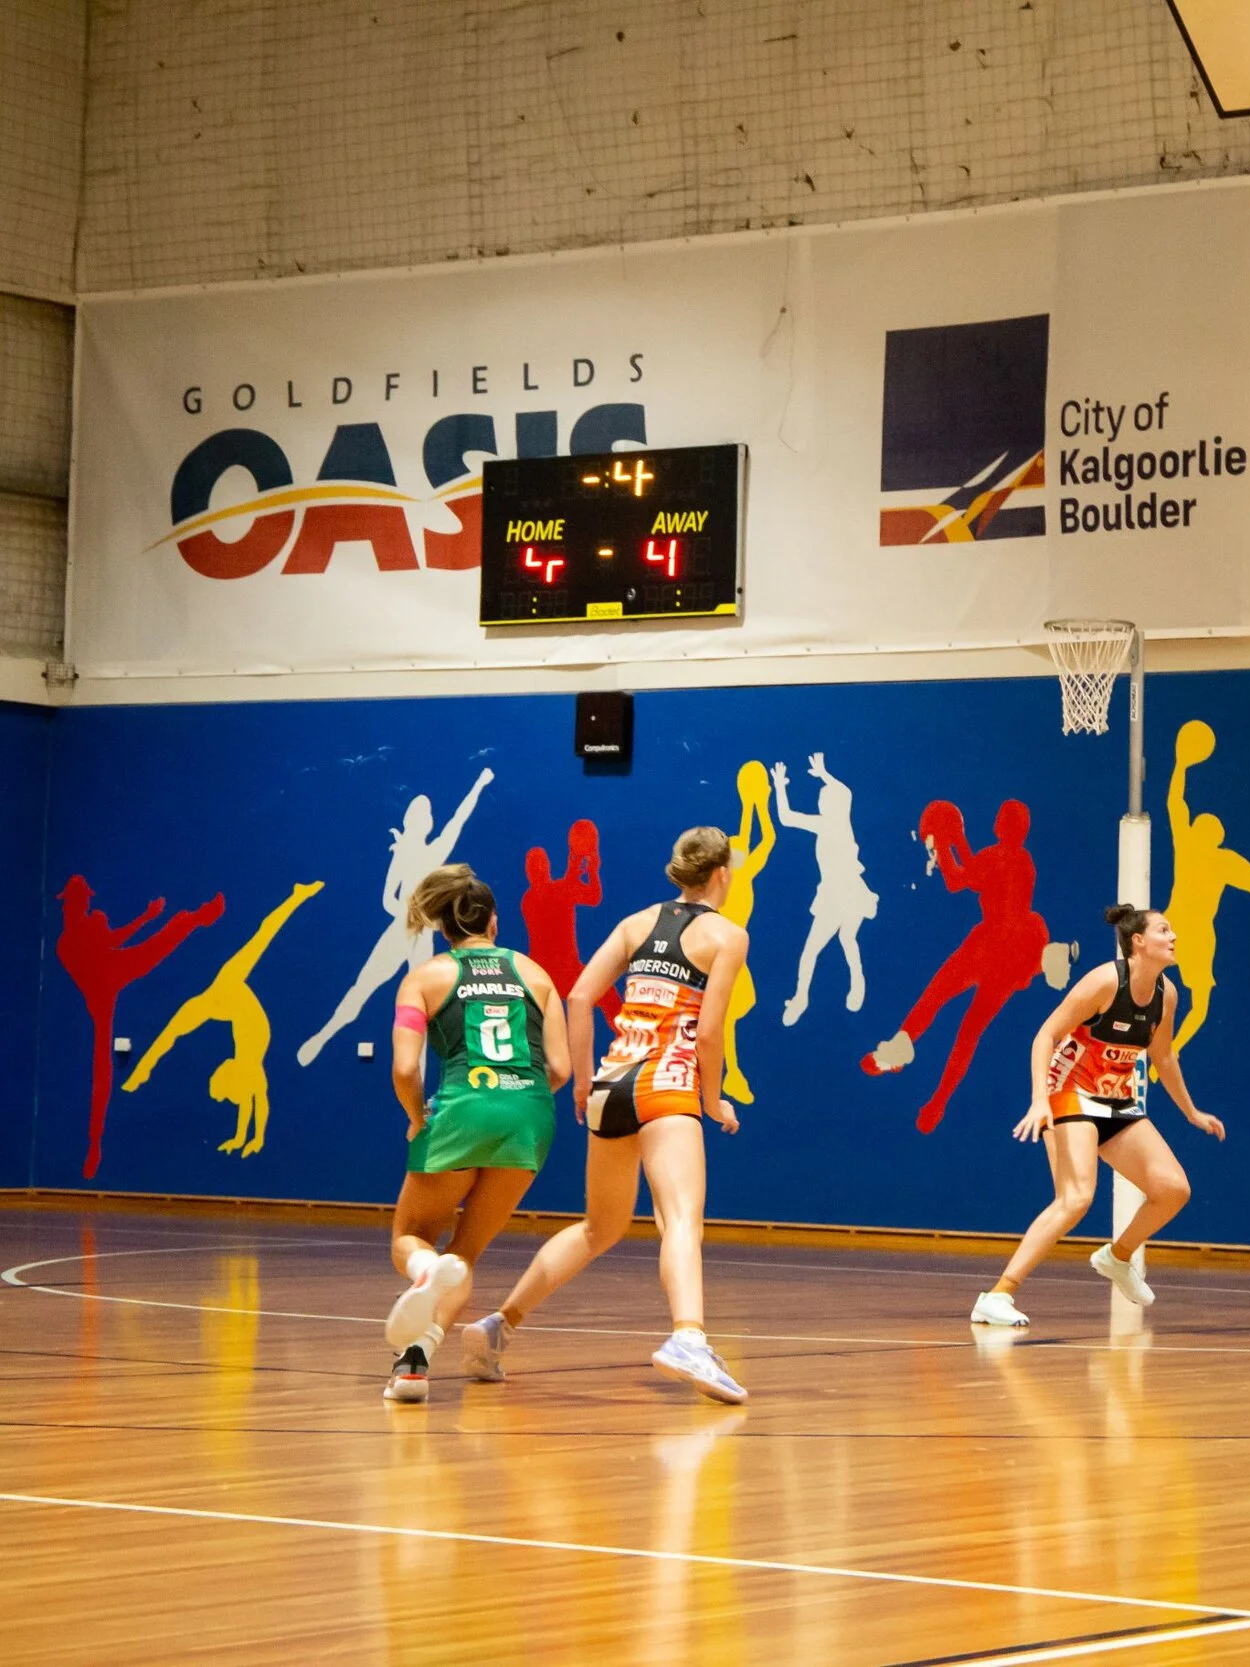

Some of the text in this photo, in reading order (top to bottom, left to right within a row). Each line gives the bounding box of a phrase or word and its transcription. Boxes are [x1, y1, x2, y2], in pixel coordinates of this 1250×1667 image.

[182, 353, 645, 415] GOLDFIELDS
[1060, 391, 1170, 442] City of
[1060, 436, 1248, 491] Kalgoorlie
[171, 402, 648, 580] OAS
[506, 510, 708, 543] HOME AWAY
[1060, 492, 1197, 535] Boulder
[653, 940, 668, 953] 10
[457, 983, 525, 998] CHARLES
[472, 968, 504, 976] PORK
[639, 984, 675, 1003] origin
[480, 1019, 514, 1062] C
[1121, 1051, 1138, 1060] HC
